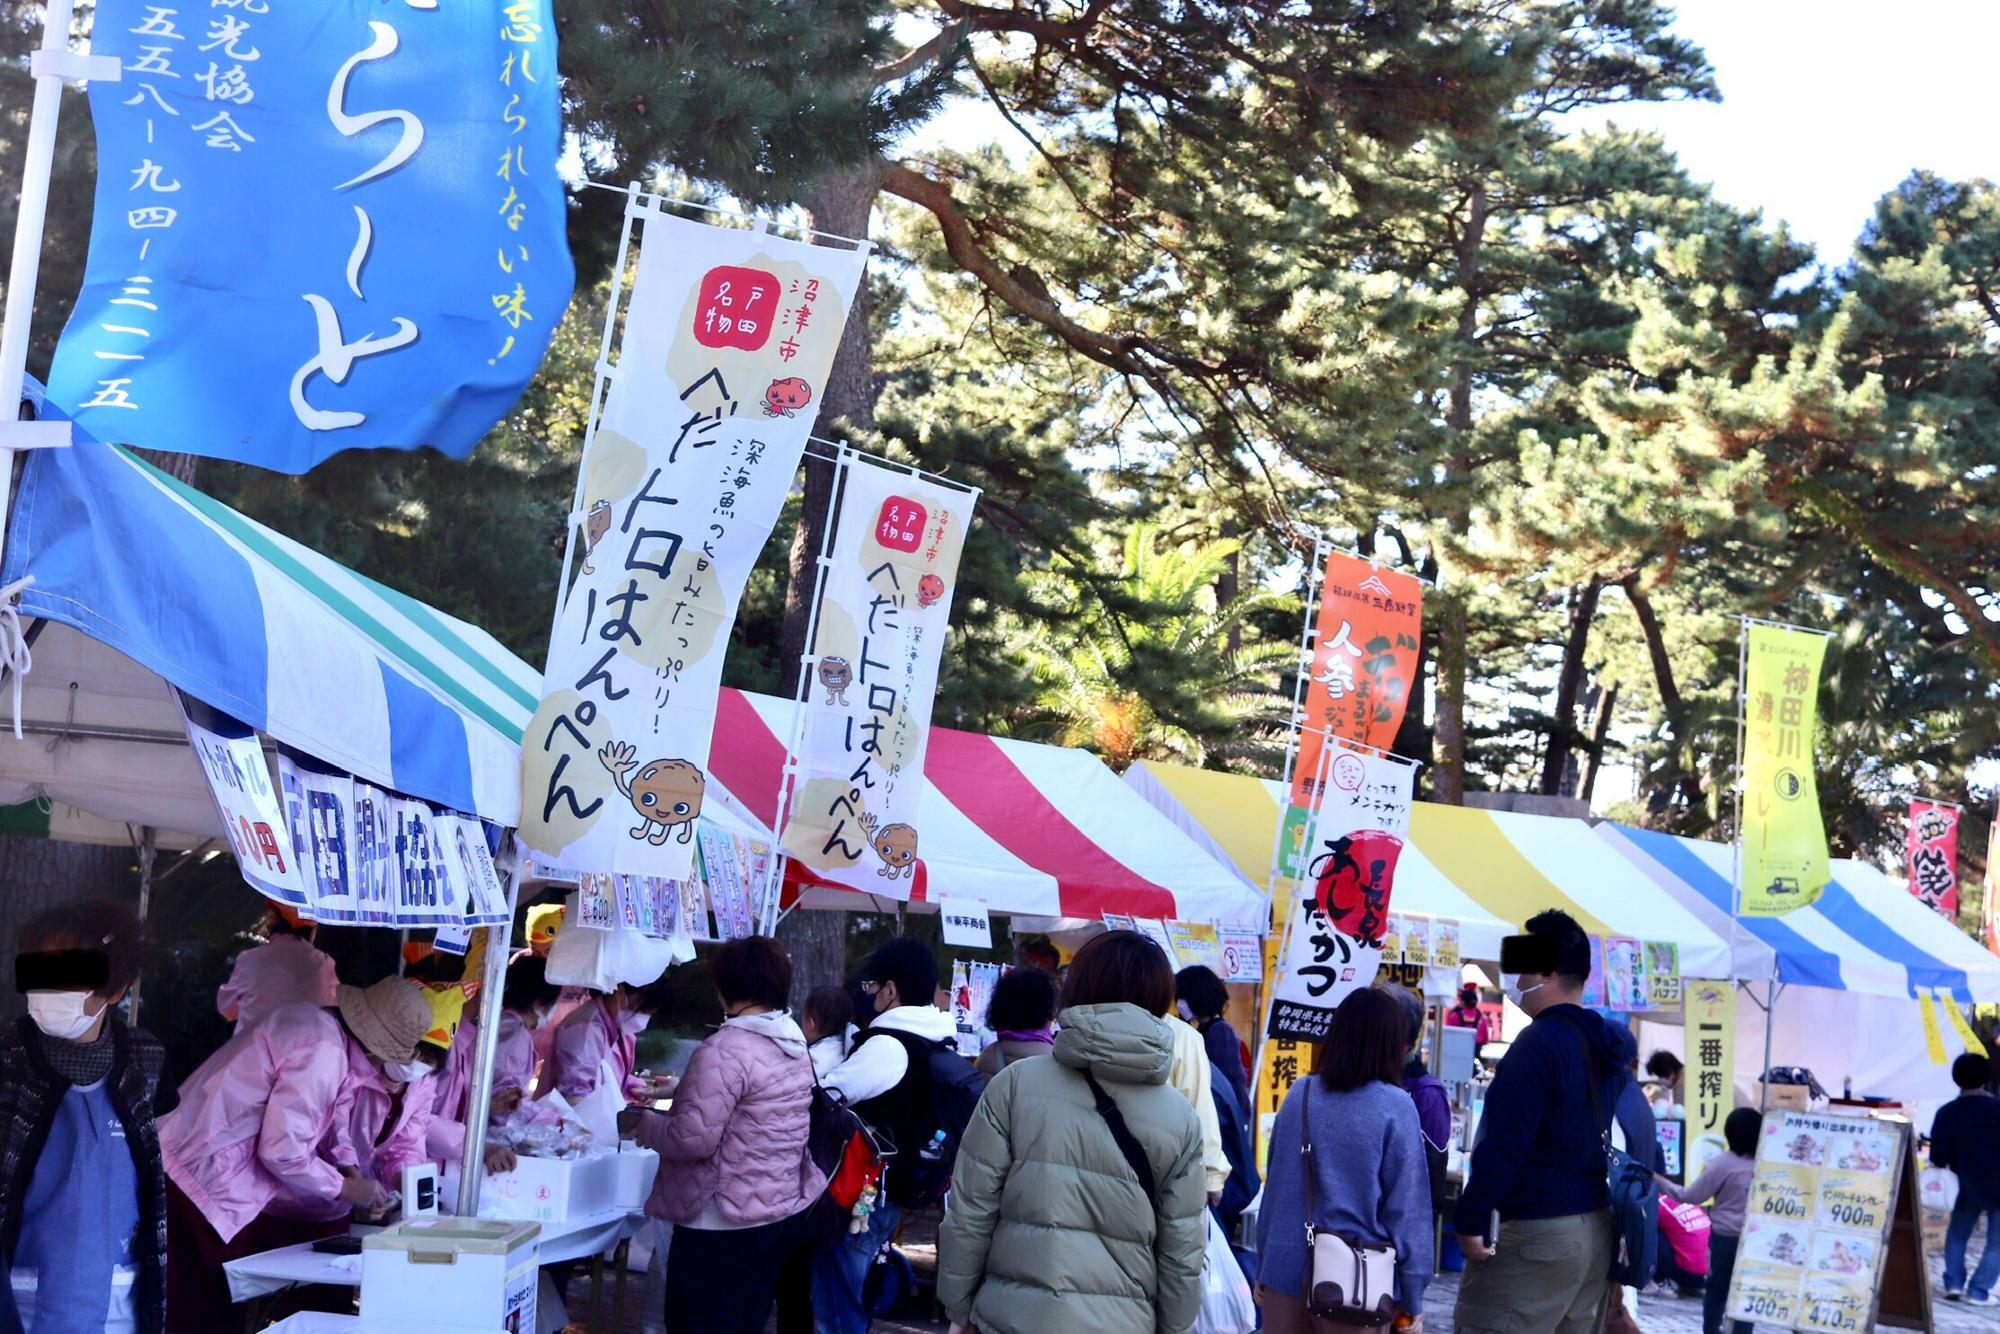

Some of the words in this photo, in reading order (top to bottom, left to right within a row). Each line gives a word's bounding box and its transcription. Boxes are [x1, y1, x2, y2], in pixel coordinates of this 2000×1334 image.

[705, 281, 732, 334] 名物
[738, 285, 765, 335] 戸田
[779, 278, 820, 363] 沼津市
[926, 510, 949, 561] 沼津市
[544, 367, 738, 824] へだトロはんぺん
[822, 562, 905, 860] へだトロはんぺん
[1776, 661, 1810, 759] 柿田川
[1297, 836, 1361, 997] あしたかつ
[1353, 860, 1386, 949] 長泉
[1654, 977, 1679, 987] チョコ
[1699, 1022, 1723, 1130] 一番搾り
[1763, 1197, 1806, 1217] 600円
[1831, 1204, 1875, 1227] 900円
[1808, 1306, 1856, 1331] 470円
